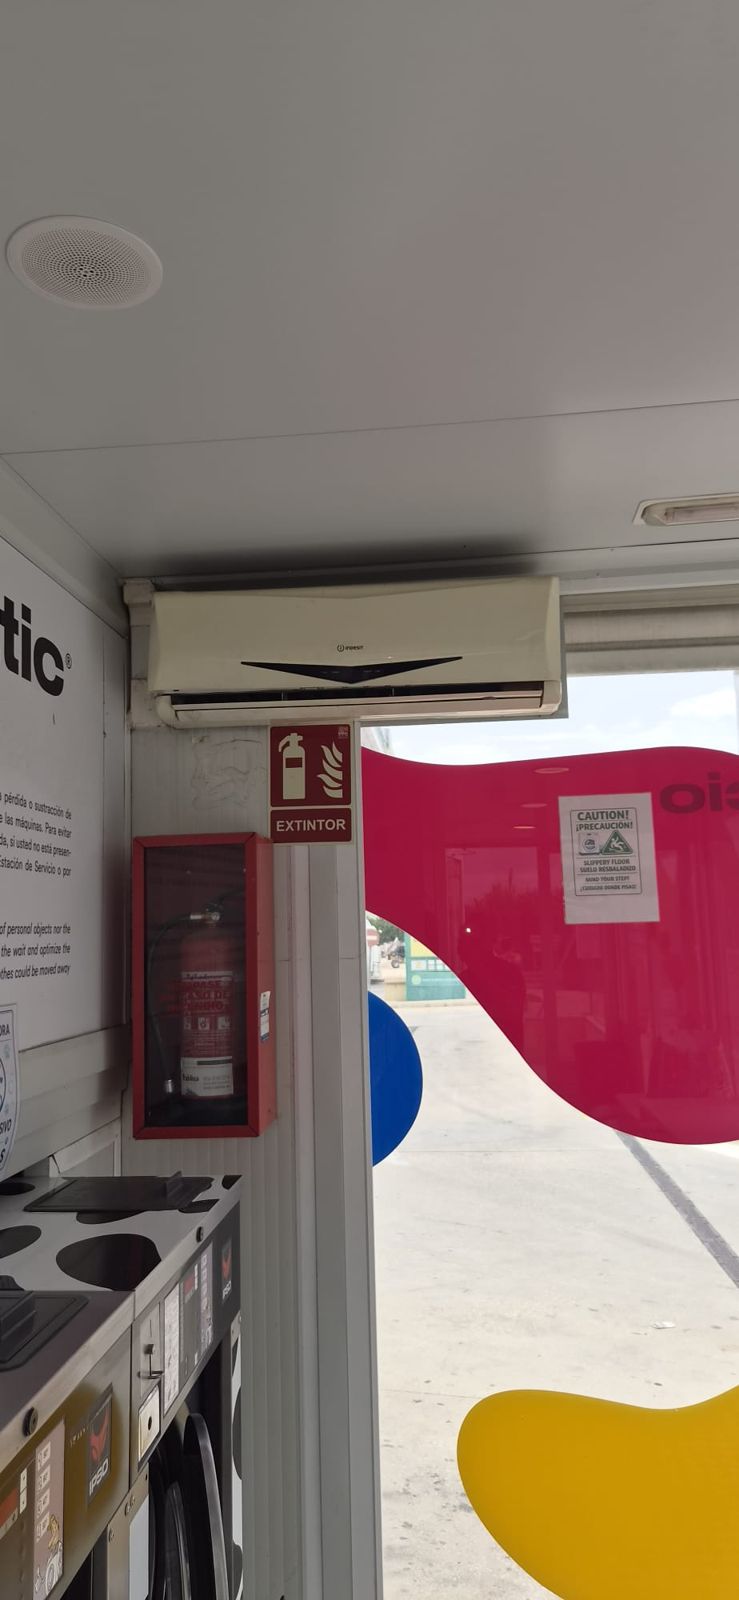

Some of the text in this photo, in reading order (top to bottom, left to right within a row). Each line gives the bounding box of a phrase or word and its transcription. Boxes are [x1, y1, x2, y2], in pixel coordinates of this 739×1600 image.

[4, 792, 72, 820] pérdida o sustracción de
[5, 811, 14, 826] las
[15, 816, 43, 832] máquinas.
[45, 822, 57, 835] Para
[58, 826, 72, 838] evitar
[577, 810, 629, 821] CAUTION!
[276, 819, 346, 832] EXTINTOR
[10, 834, 16, 848] si
[16, 839, 32, 851] usted
[33, 842, 41, 853] no
[41, 842, 53, 855] está
[25, 858, 33, 872] de
[34, 860, 56, 875] Servicio
[57, 866, 62, 876] o
[63, 867, 72, 878] por
[7, 921, 33, 938] personal
[33, 922, 52, 938] objects
[53, 925, 63, 934] nor
[63, 923, 71, 934] the
[1, 942, 71, 957] the wait and optimize the
[15, 964, 31, 978] could
[31, 964, 39, 977] be
[40, 963, 57, 976] moved
[57, 965, 71, 976] away
[89, 1457, 109, 1496] IPSO
